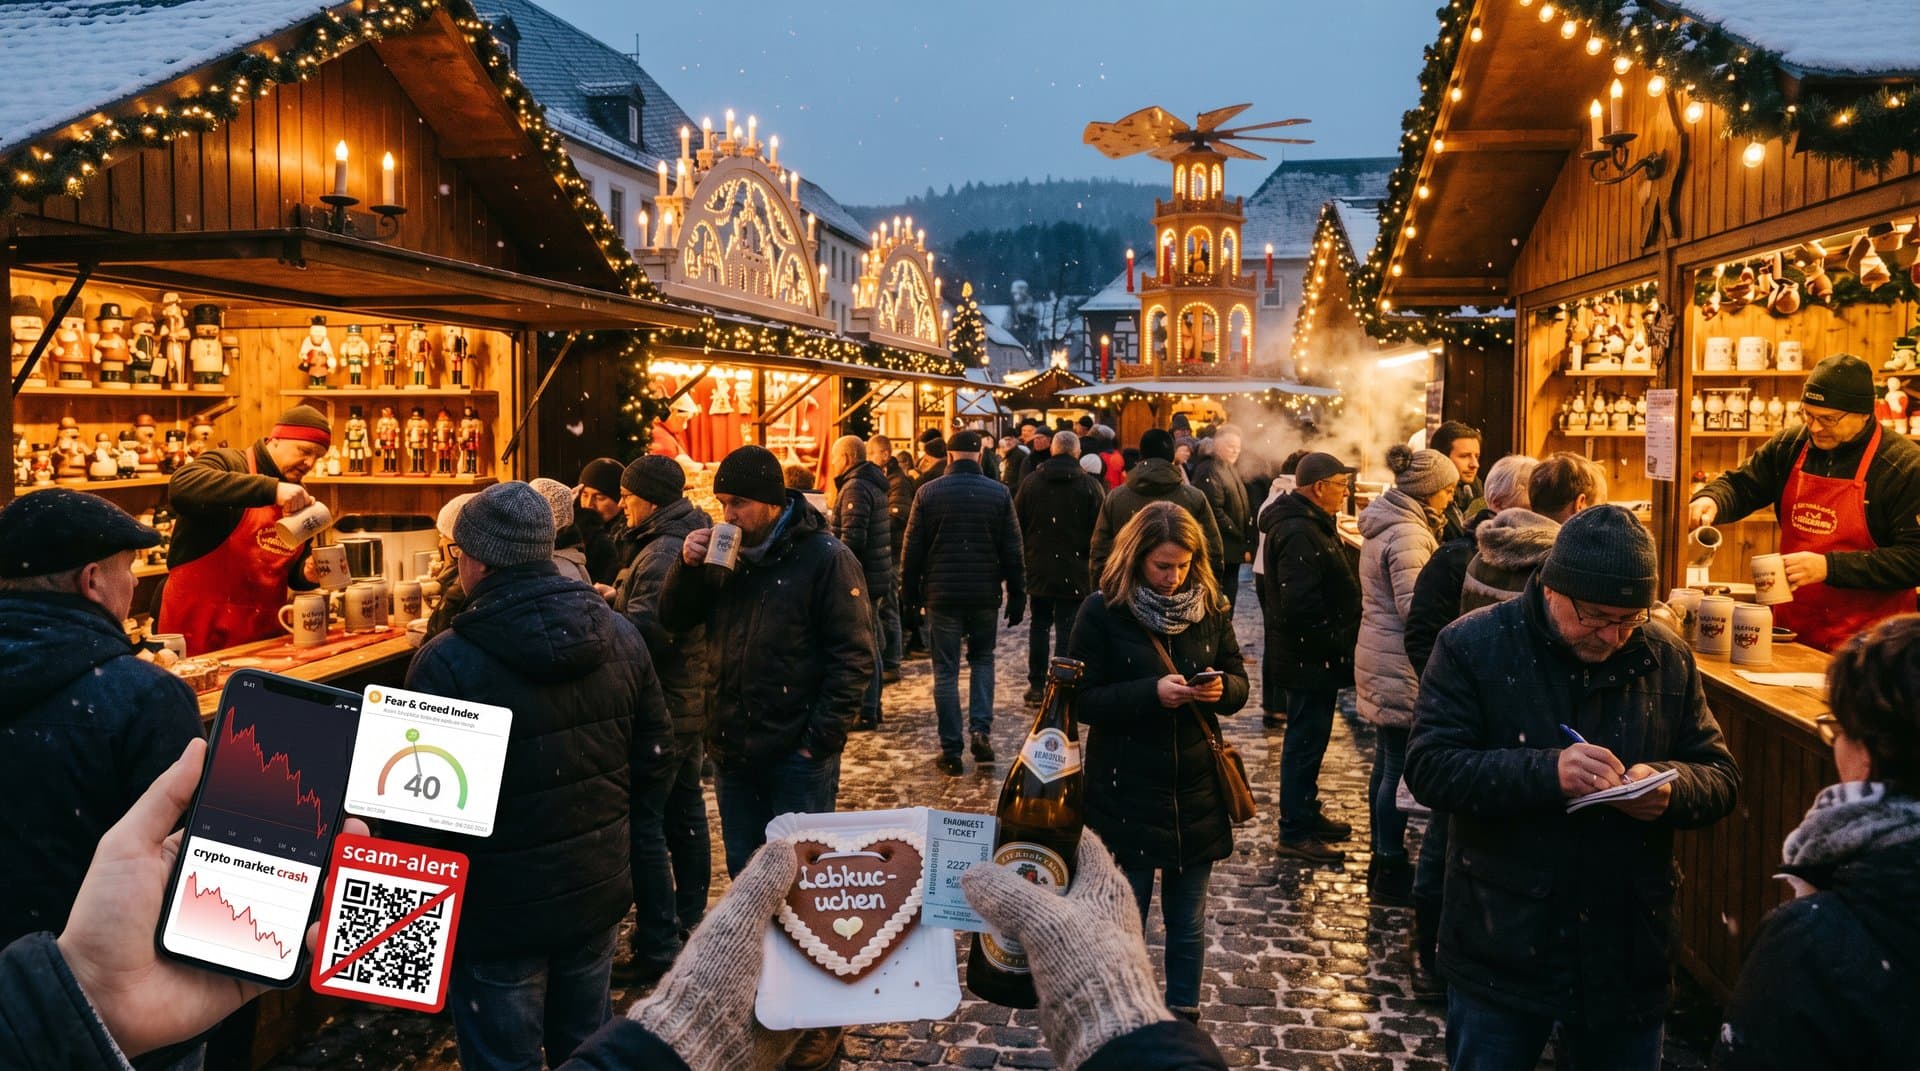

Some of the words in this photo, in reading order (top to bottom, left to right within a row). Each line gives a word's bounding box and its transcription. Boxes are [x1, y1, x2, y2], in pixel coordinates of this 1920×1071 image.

[947, 828, 977, 838] TICKET
[193, 848, 231, 864] crypto
[233, 857, 275, 875] market
[276, 868, 309, 883] crash
[799, 865, 897, 890] Lebkuc-
[814, 889, 886, 912] uchen
